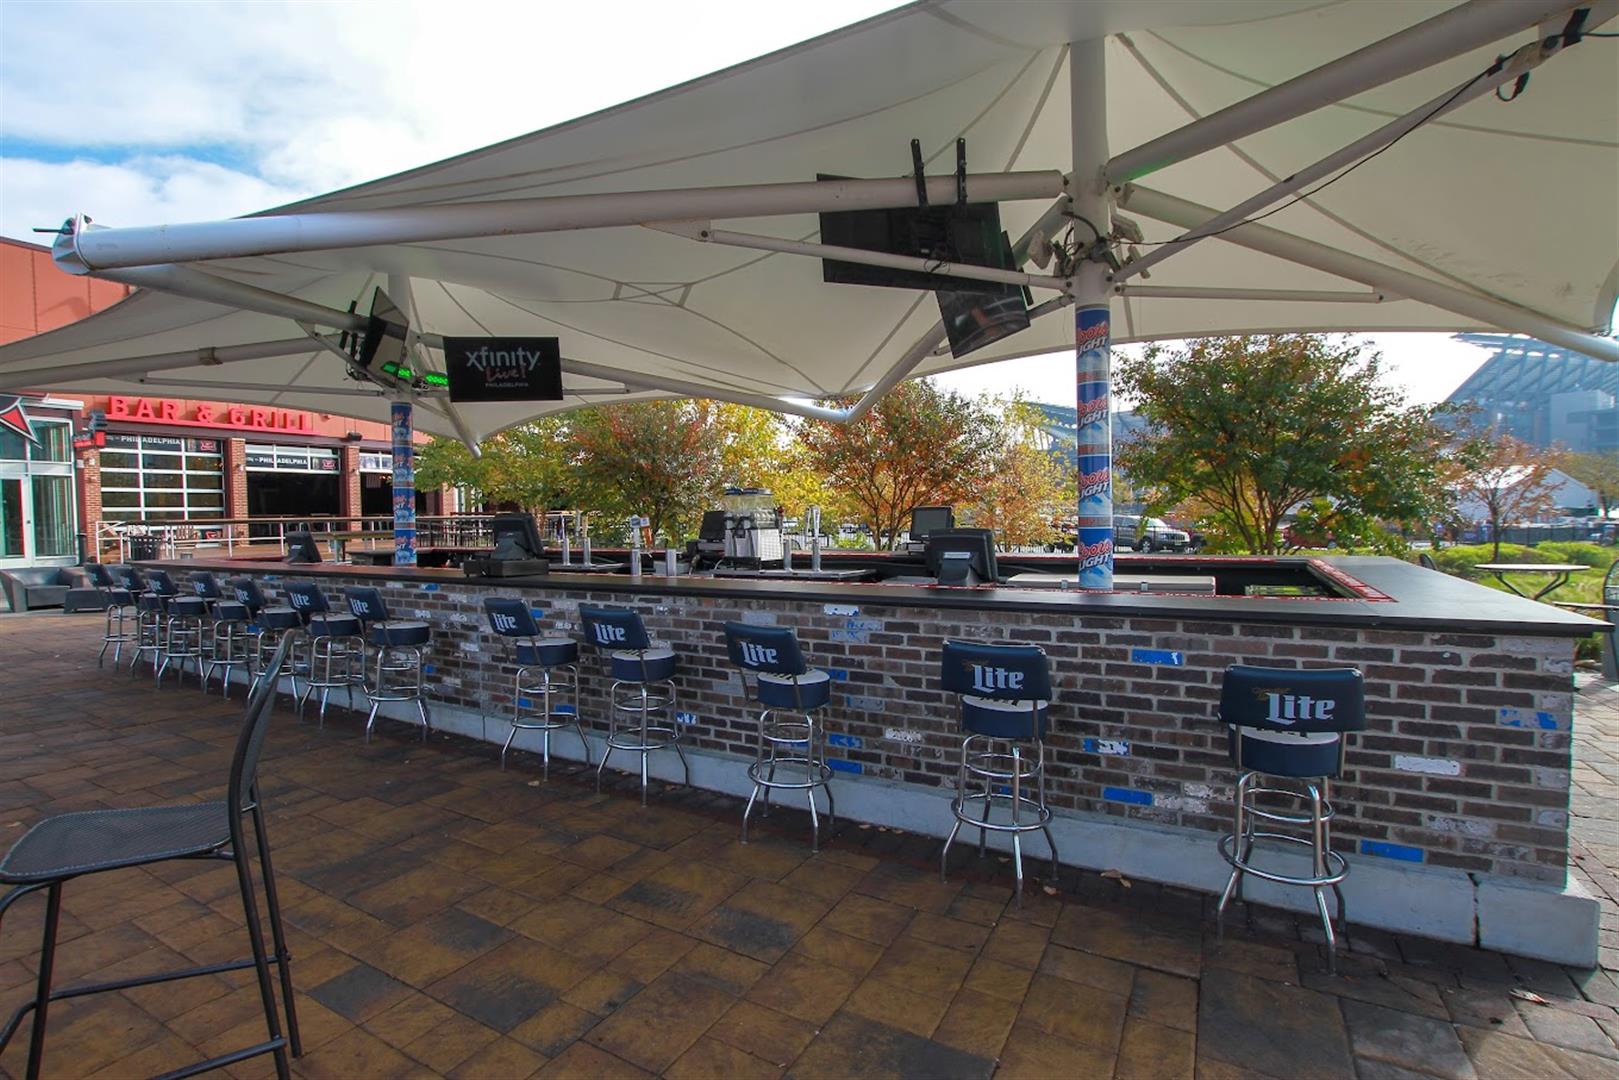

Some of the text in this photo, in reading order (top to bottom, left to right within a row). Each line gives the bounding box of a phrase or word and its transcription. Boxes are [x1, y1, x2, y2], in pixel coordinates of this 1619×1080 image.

[465, 346, 541, 371] xfinity
[108, 396, 311, 431] BAR & GRILL
[289, 592, 310, 609] Lite
[349, 599, 369, 616] Lite
[492, 613, 516, 633] Lite
[594, 622, 626, 644] Lite
[740, 641, 778, 666] Lite
[971, 664, 1024, 693] Lite
[1264, 691, 1335, 726] Lite
